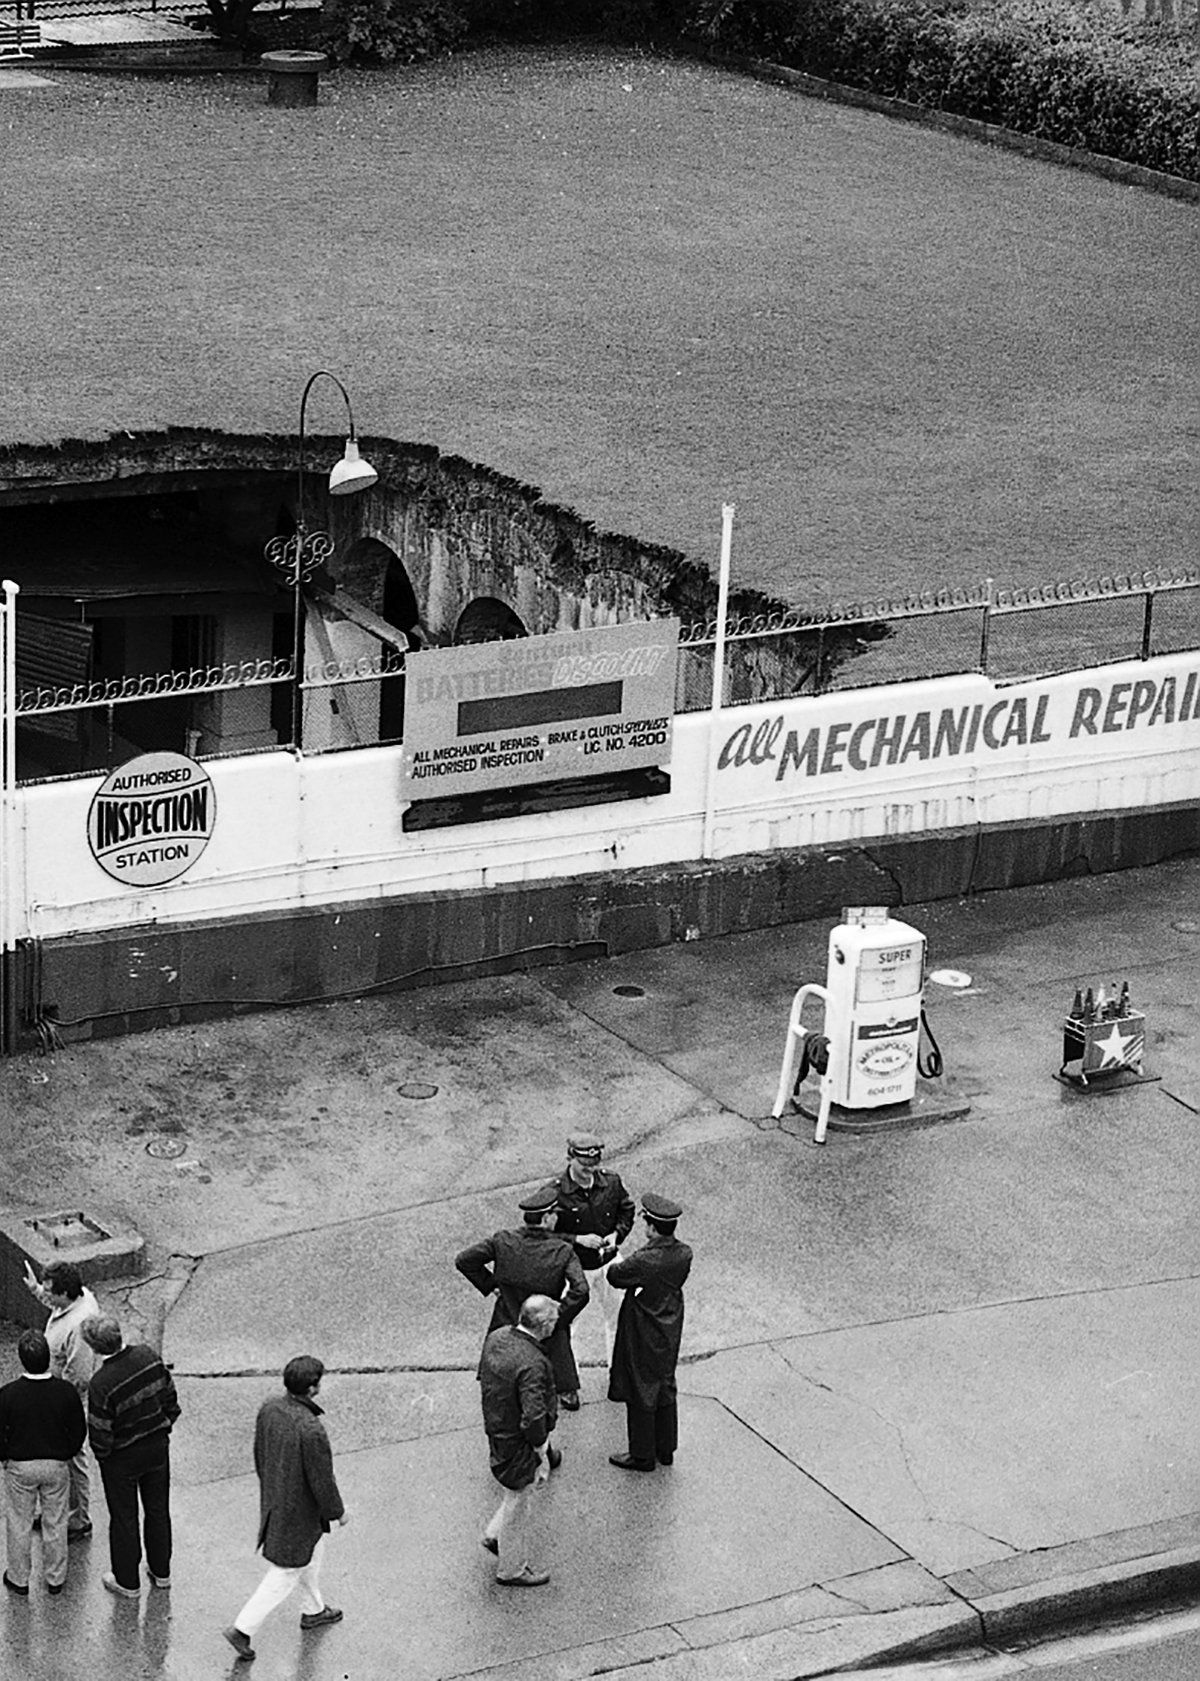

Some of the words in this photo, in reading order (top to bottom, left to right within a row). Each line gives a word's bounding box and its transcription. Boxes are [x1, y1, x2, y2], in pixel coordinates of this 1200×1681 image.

[411, 758, 477, 779] AUTHORISED
[480, 749, 544, 770] INSPECTION
[605, 737, 626, 752] NO.
[628, 731, 667, 748] 4200
[413, 750, 430, 764] ALL
[433, 741, 497, 761] MECHANICAL
[500, 735, 540, 752] REPAIRS
[548, 729, 578, 745] BRAKE
[588, 723, 624, 739] CLUTCH
[775, 694, 1052, 782] MECHANICAL
[111, 767, 192, 792] AUTHORISED
[96, 785, 208, 851] INSPECTION
[115, 843, 189, 869] STATION
[879, 949, 912, 965] SUPER
